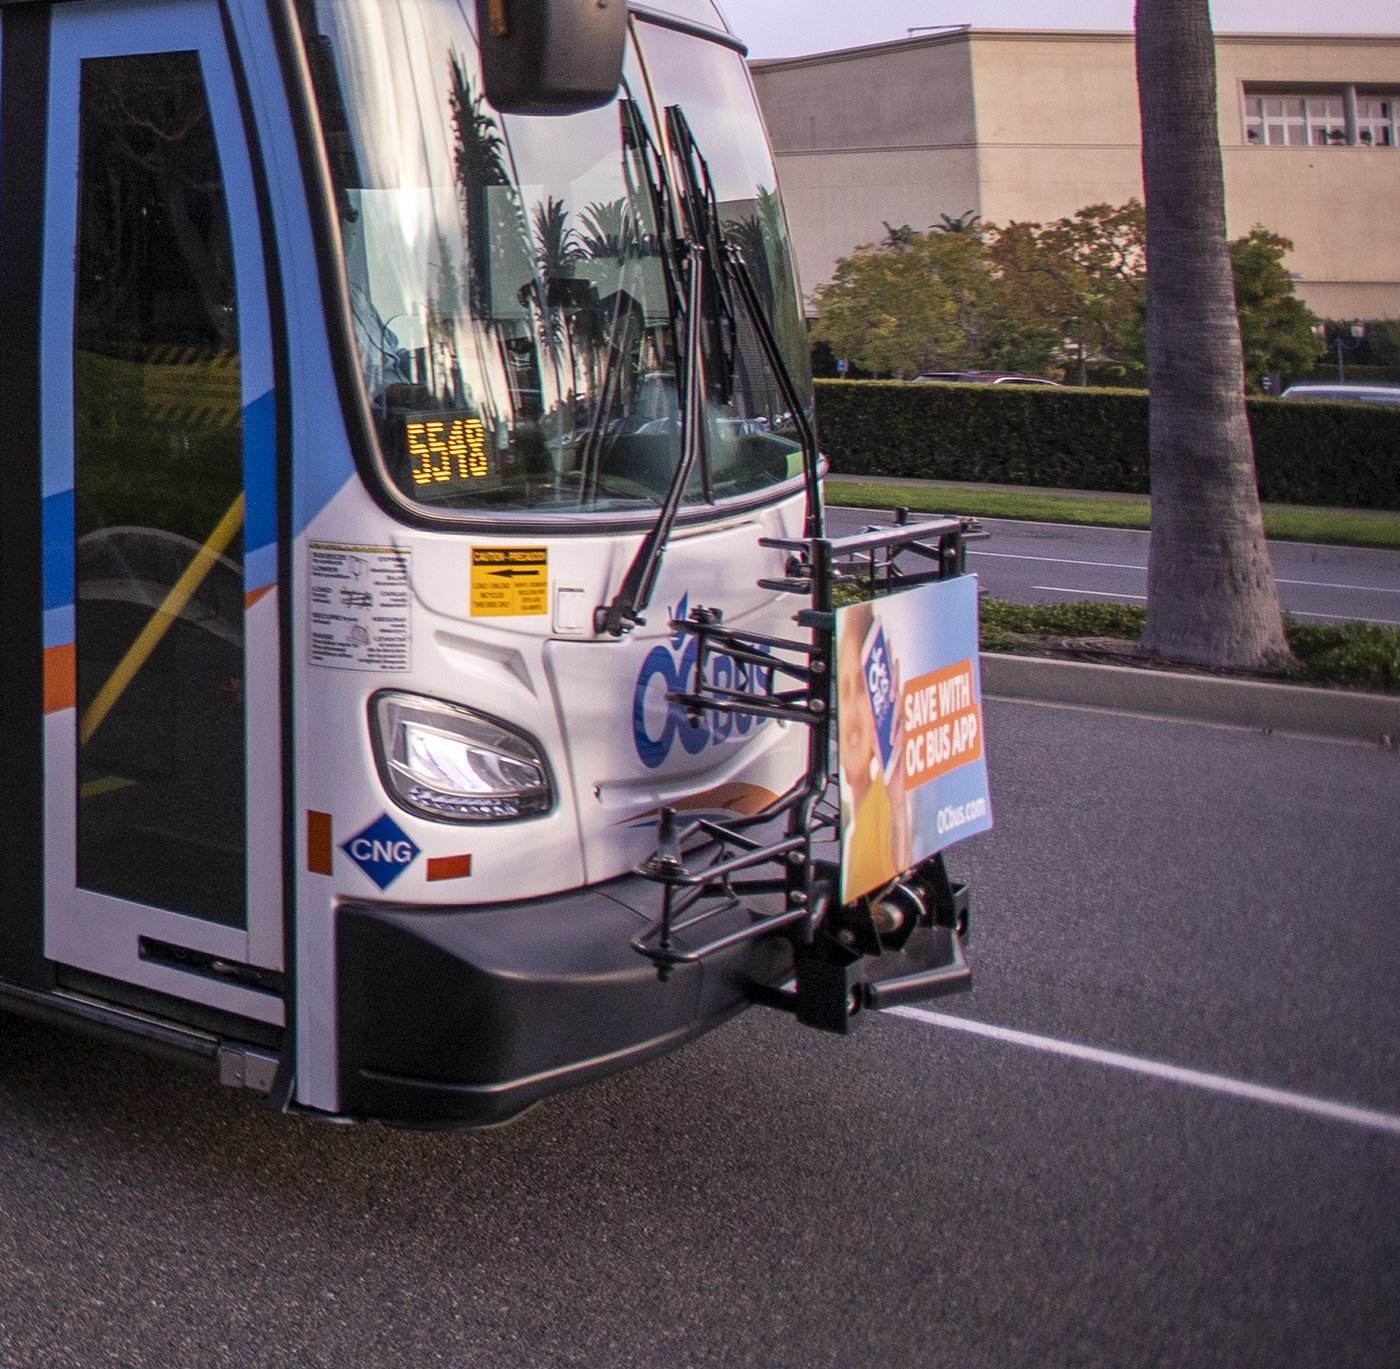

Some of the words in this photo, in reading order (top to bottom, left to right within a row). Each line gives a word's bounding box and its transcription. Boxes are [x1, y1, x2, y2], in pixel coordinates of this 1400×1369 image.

[904, 685, 938, 732] SAVE
[938, 672, 971, 717] WITH
[905, 734, 925, 778] OC
[926, 723, 951, 769] BUS
[951, 713, 978, 756] APP
[936, 797, 987, 835] OCbus.com
[349, 838, 413, 865] CNG
